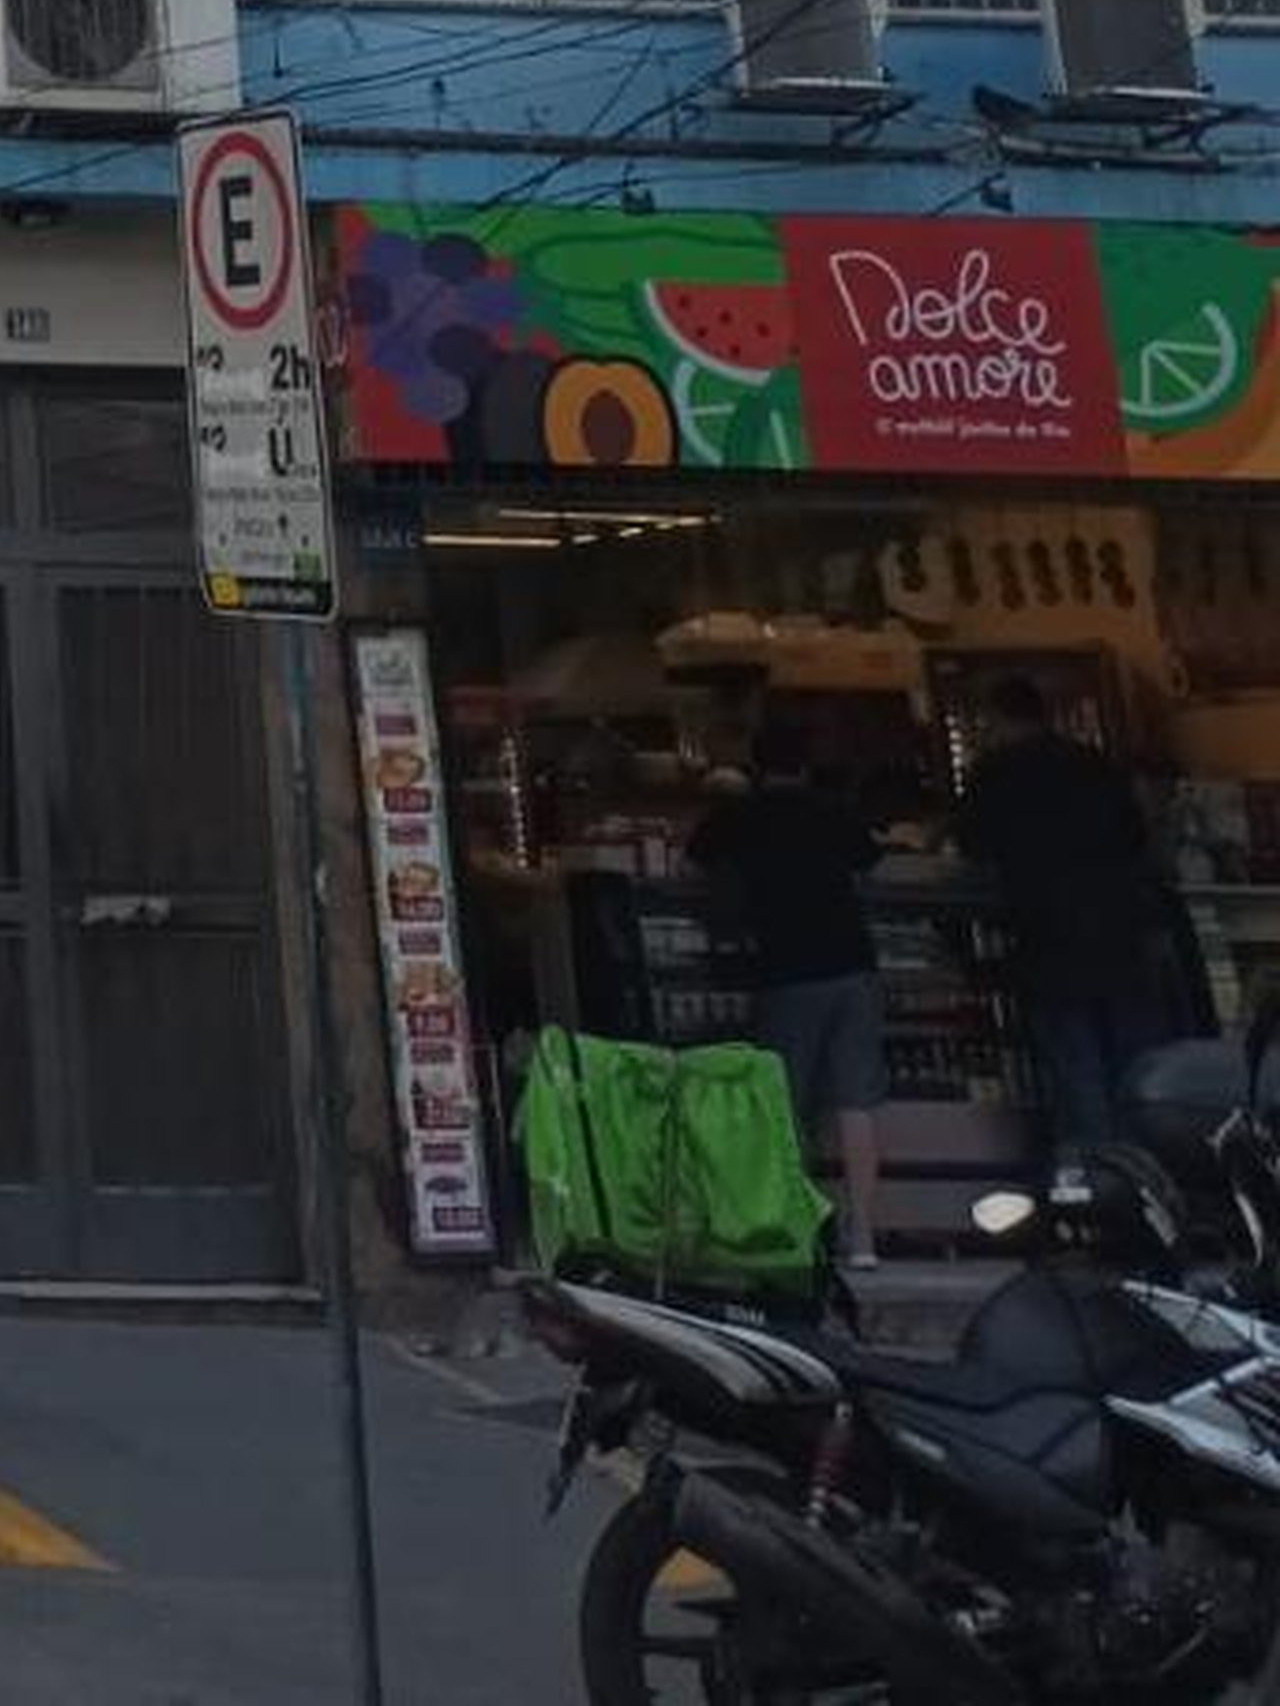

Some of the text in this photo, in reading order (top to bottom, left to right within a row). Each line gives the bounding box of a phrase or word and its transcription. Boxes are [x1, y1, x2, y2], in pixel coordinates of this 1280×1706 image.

[219, 175, 262, 287] E
[826, 249, 1068, 355] Dolce
[269, 344, 312, 392] 2h
[868, 347, 1074, 409] amore
